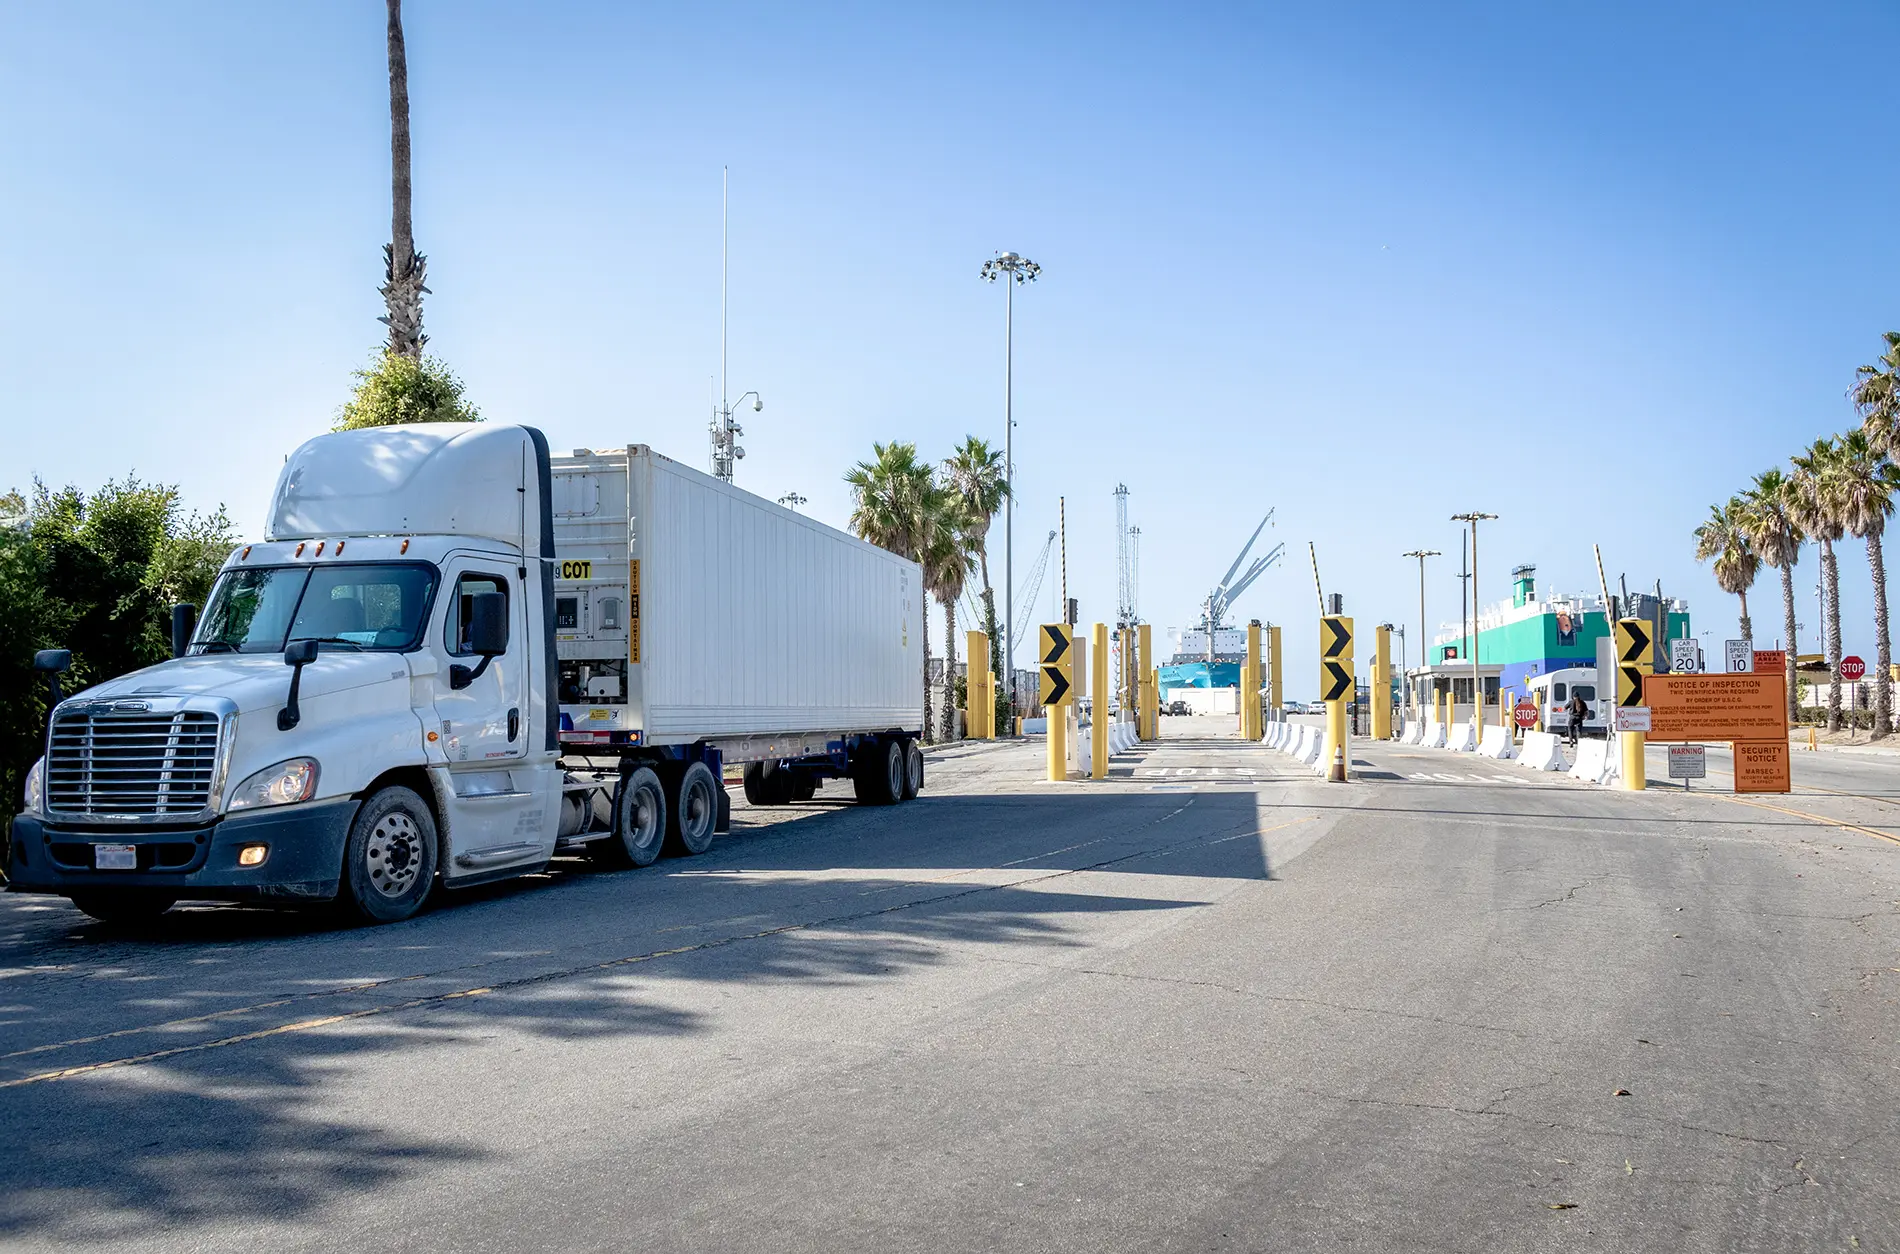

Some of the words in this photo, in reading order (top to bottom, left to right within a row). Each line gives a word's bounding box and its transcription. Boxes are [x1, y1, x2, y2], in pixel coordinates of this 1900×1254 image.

[563, 562, 590, 578] COT
[1676, 659, 1694, 670] 20
[1733, 660, 1746, 671] 10
[1842, 663, 1864, 672] STOP
[1516, 710, 1536, 720] STOP
[1616, 710, 1625, 718] NO
[1621, 720, 1629, 728] NO
